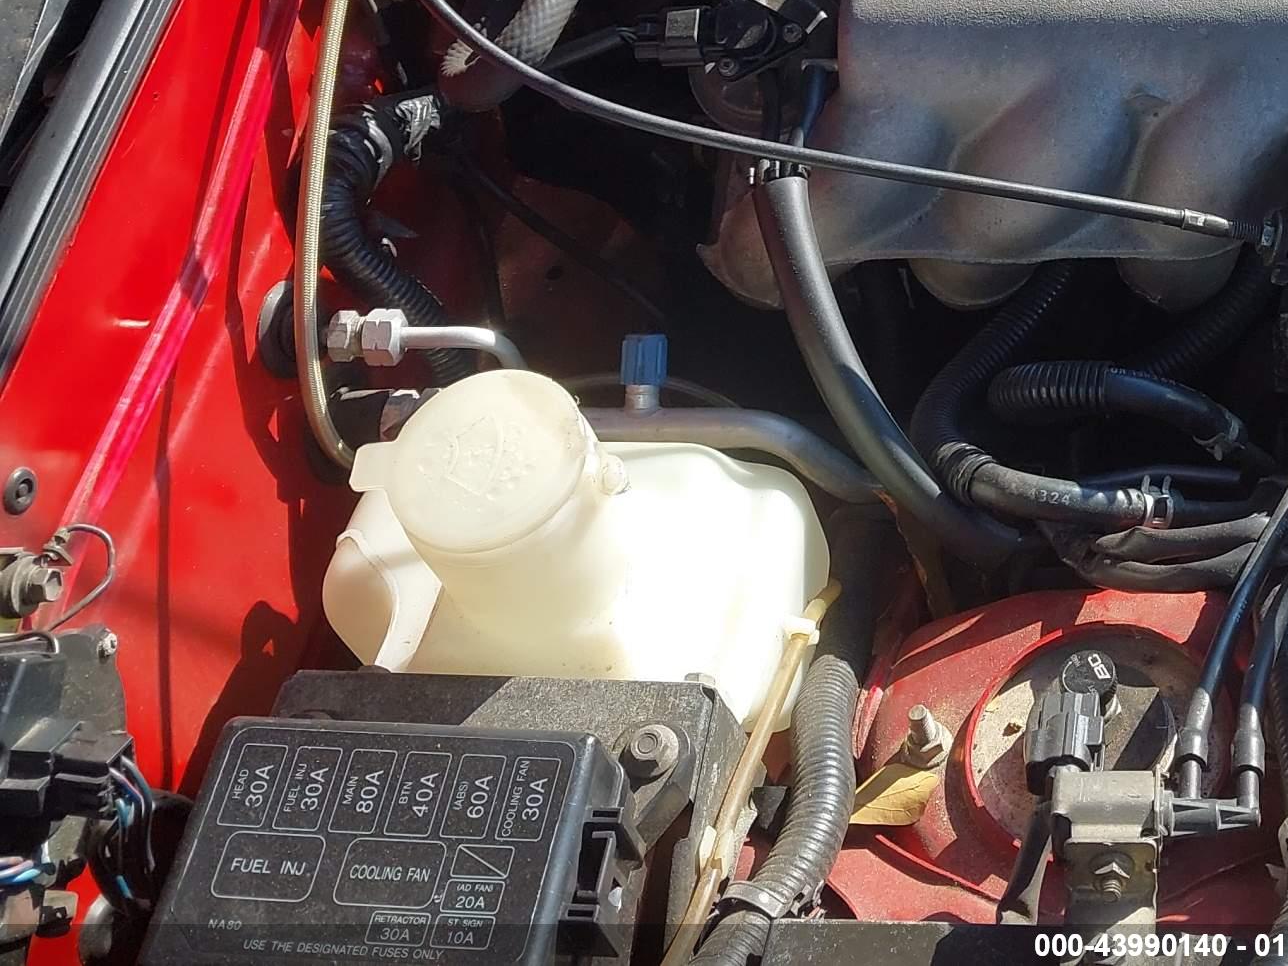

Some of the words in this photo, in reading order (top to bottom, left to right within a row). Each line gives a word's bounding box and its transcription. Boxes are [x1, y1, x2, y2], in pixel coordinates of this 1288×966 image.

[1088, 653, 1111, 679] BC
[232, 769, 249, 801] HEAD
[245, 764, 275, 808] 30A
[283, 785, 301, 813] FUEL
[295, 763, 308, 780] INJ
[300, 767, 329, 812] 30A
[342, 776, 359, 805] MAIN
[356, 770, 384, 815] 80A
[399, 781, 413, 804] BTN
[412, 772, 440, 818] 40A
[467, 775, 493, 819] 60A
[501, 786, 523, 837] COOLING
[518, 760, 531, 782] FAN
[522, 778, 548, 822] 30A
[230, 857, 272, 874] FUEL
[280, 860, 306, 876] INJ
[349, 863, 403, 882] COOLING
[406, 867, 431, 883] FAN
[455, 896, 485, 909] 20A
[374, 914, 427, 925] RETRACTOR
[447, 919, 458, 927] ST
[463, 919, 484, 927] SIGN
[380, 927, 410, 941] 30A
[447, 931, 474, 945] 10A
[243, 939, 267, 950] USE
[271, 940, 294, 952] THE
[296, 942, 368, 956] DESIGNATED
[371, 946, 409, 958] FUSES
[412, 949, 444, 960] ONLY
